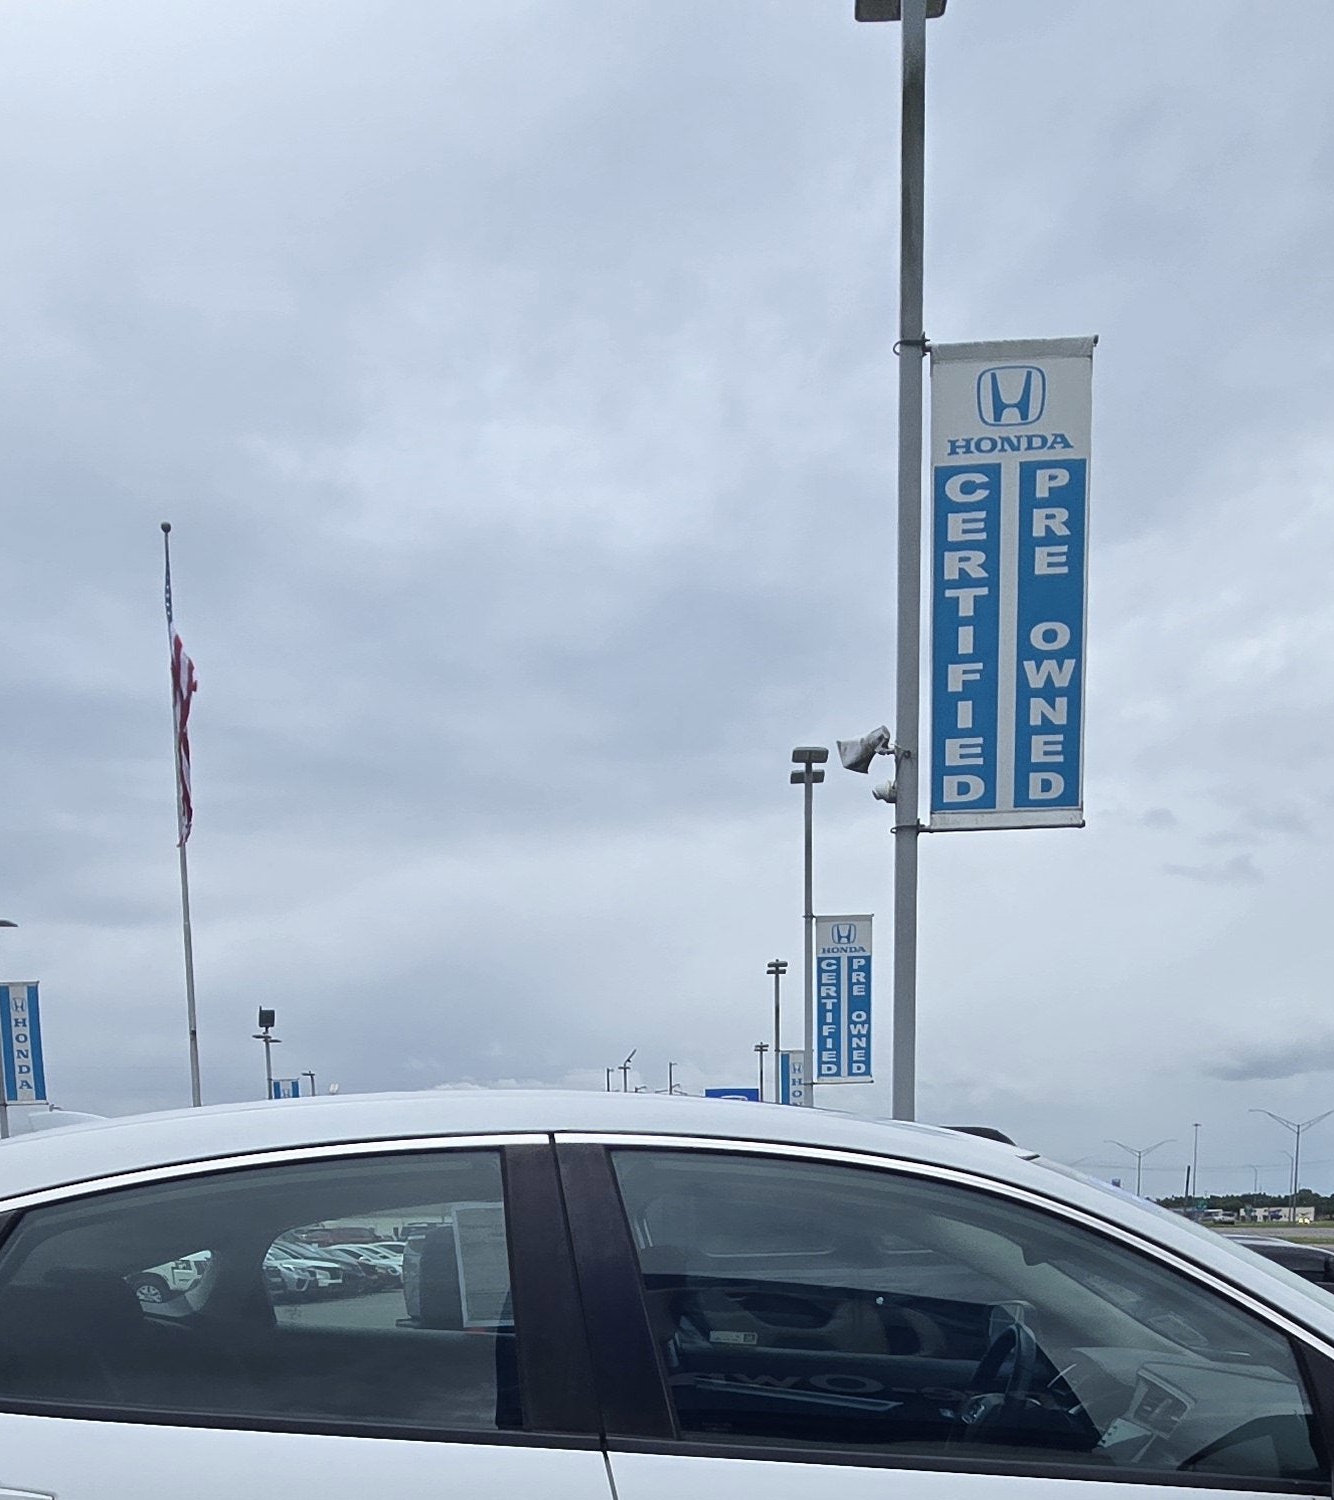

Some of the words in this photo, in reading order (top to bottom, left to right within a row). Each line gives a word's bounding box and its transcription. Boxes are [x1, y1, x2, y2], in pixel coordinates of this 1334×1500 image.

[947, 433, 1074, 456] HONDA
[1032, 467, 1071, 576] PRE
[943, 472, 991, 803] CERTIFIED
[1023, 621, 1077, 801] OWNED
[821, 946, 867, 954] HONDA
[851, 958, 866, 996] PRE
[820, 959, 838, 1075] CERTIFIED
[849, 1010, 869, 1074] OWNED
[13, 1018, 34, 1090] HONDA
